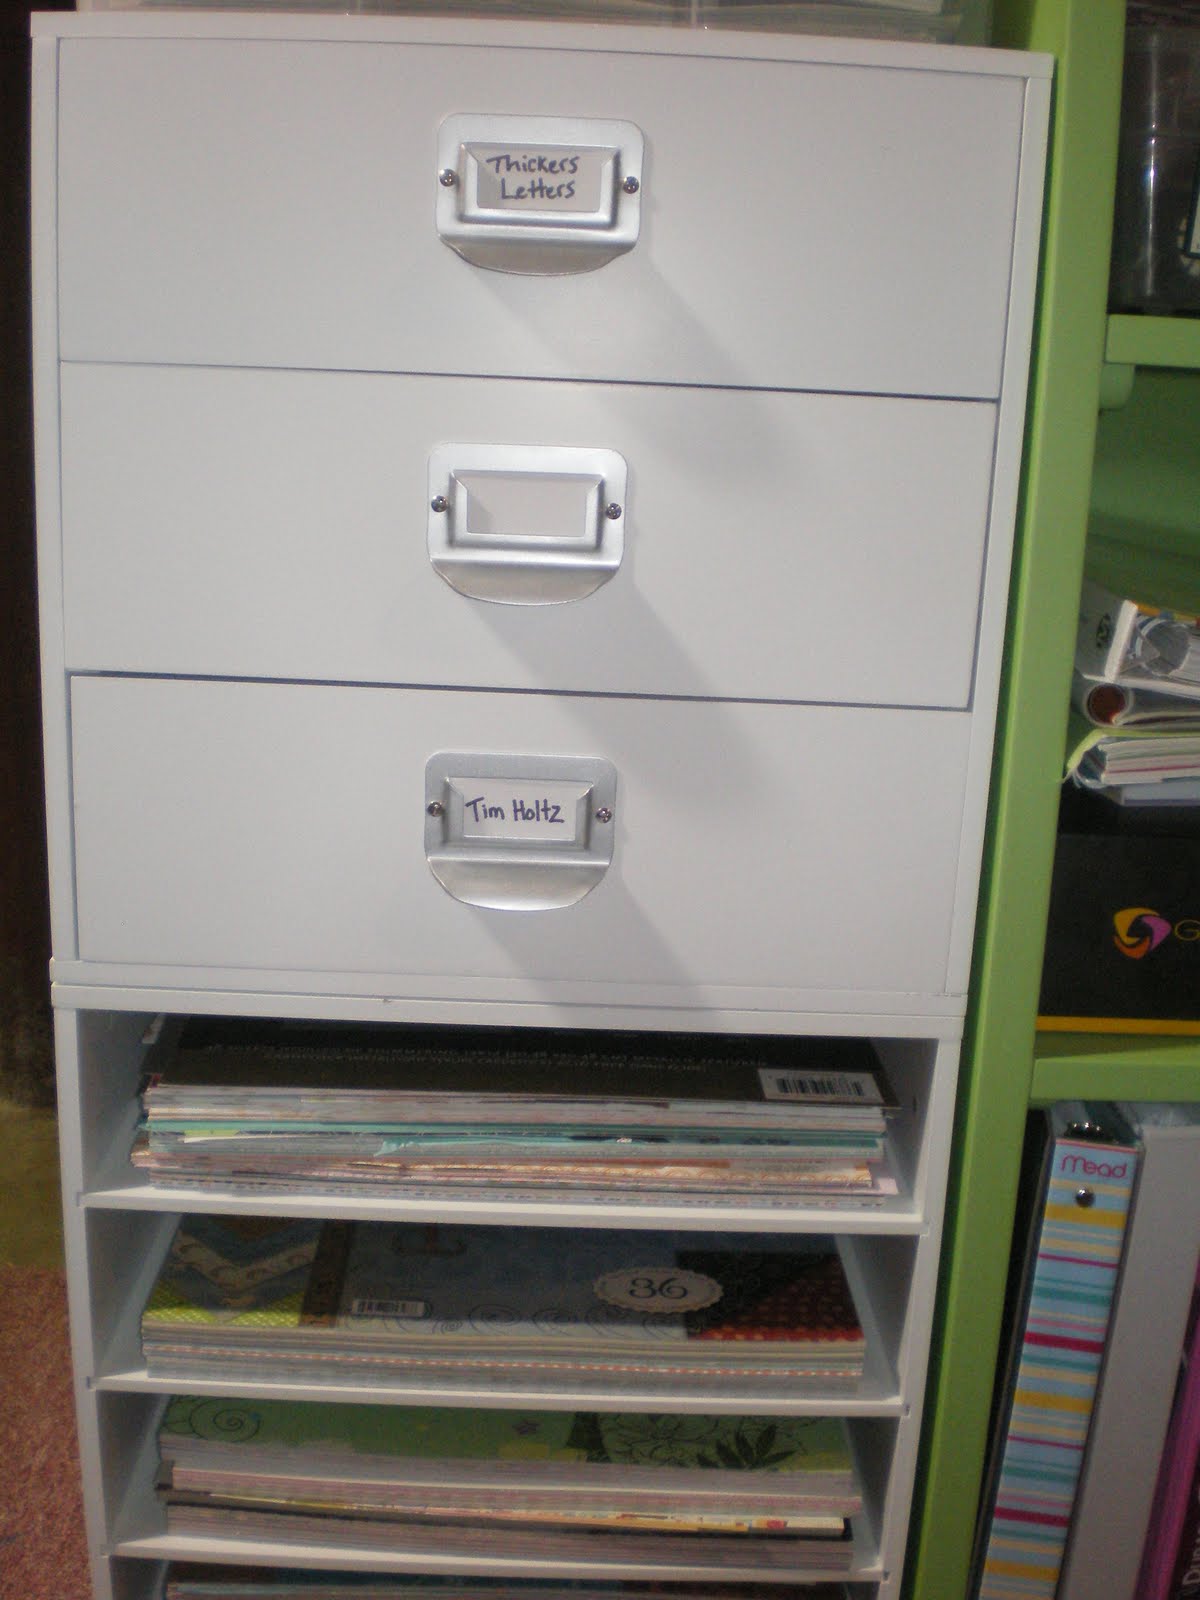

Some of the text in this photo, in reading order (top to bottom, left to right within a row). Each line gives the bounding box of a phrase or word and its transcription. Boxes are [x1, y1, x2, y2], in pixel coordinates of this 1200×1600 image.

[486, 154, 580, 175] Thickers
[501, 177, 576, 200] Letters
[465, 796, 565, 824] Tim Holtz
[629, 1277, 688, 1300] 36
